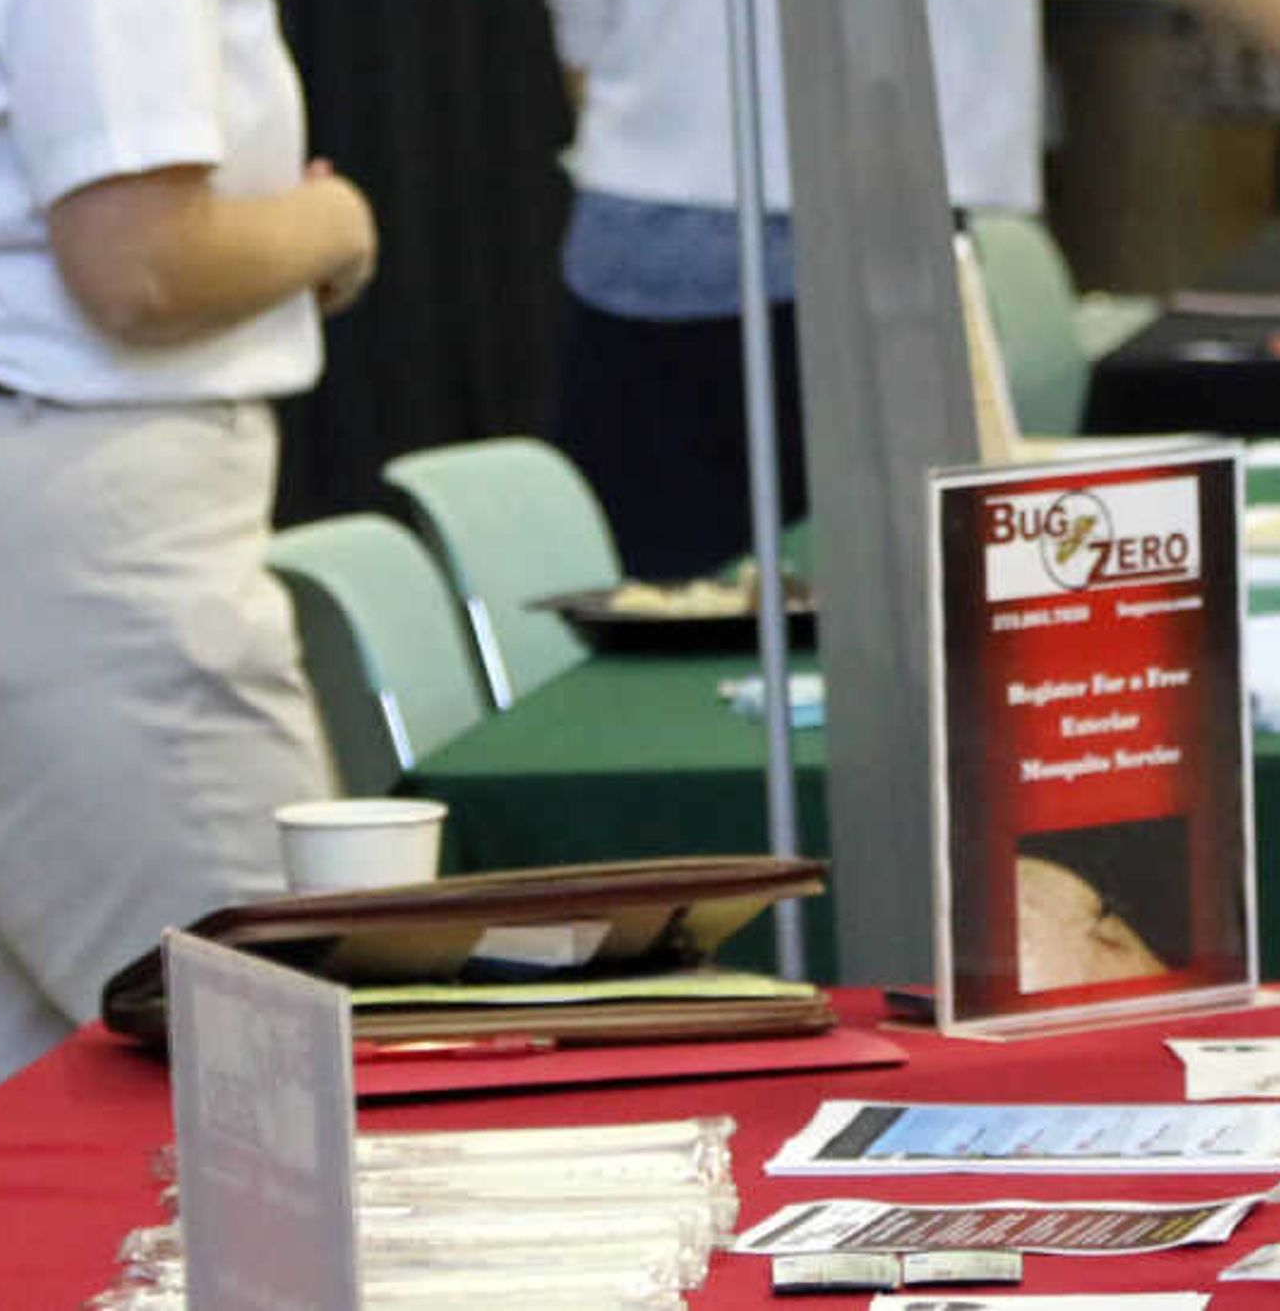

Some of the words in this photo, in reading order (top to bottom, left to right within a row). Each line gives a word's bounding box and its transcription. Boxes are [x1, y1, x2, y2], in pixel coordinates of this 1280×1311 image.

[983, 501, 1068, 544] BUG
[1087, 532, 1190, 584] ZERO
[1007, 680, 1088, 707] Register
[1092, 673, 1125, 696] For
[1147, 666, 1191, 689] Free
[1061, 712, 1141, 738] Exterior
[1021, 752, 1111, 783] Mosquito
[1115, 745, 1182, 770] Service
